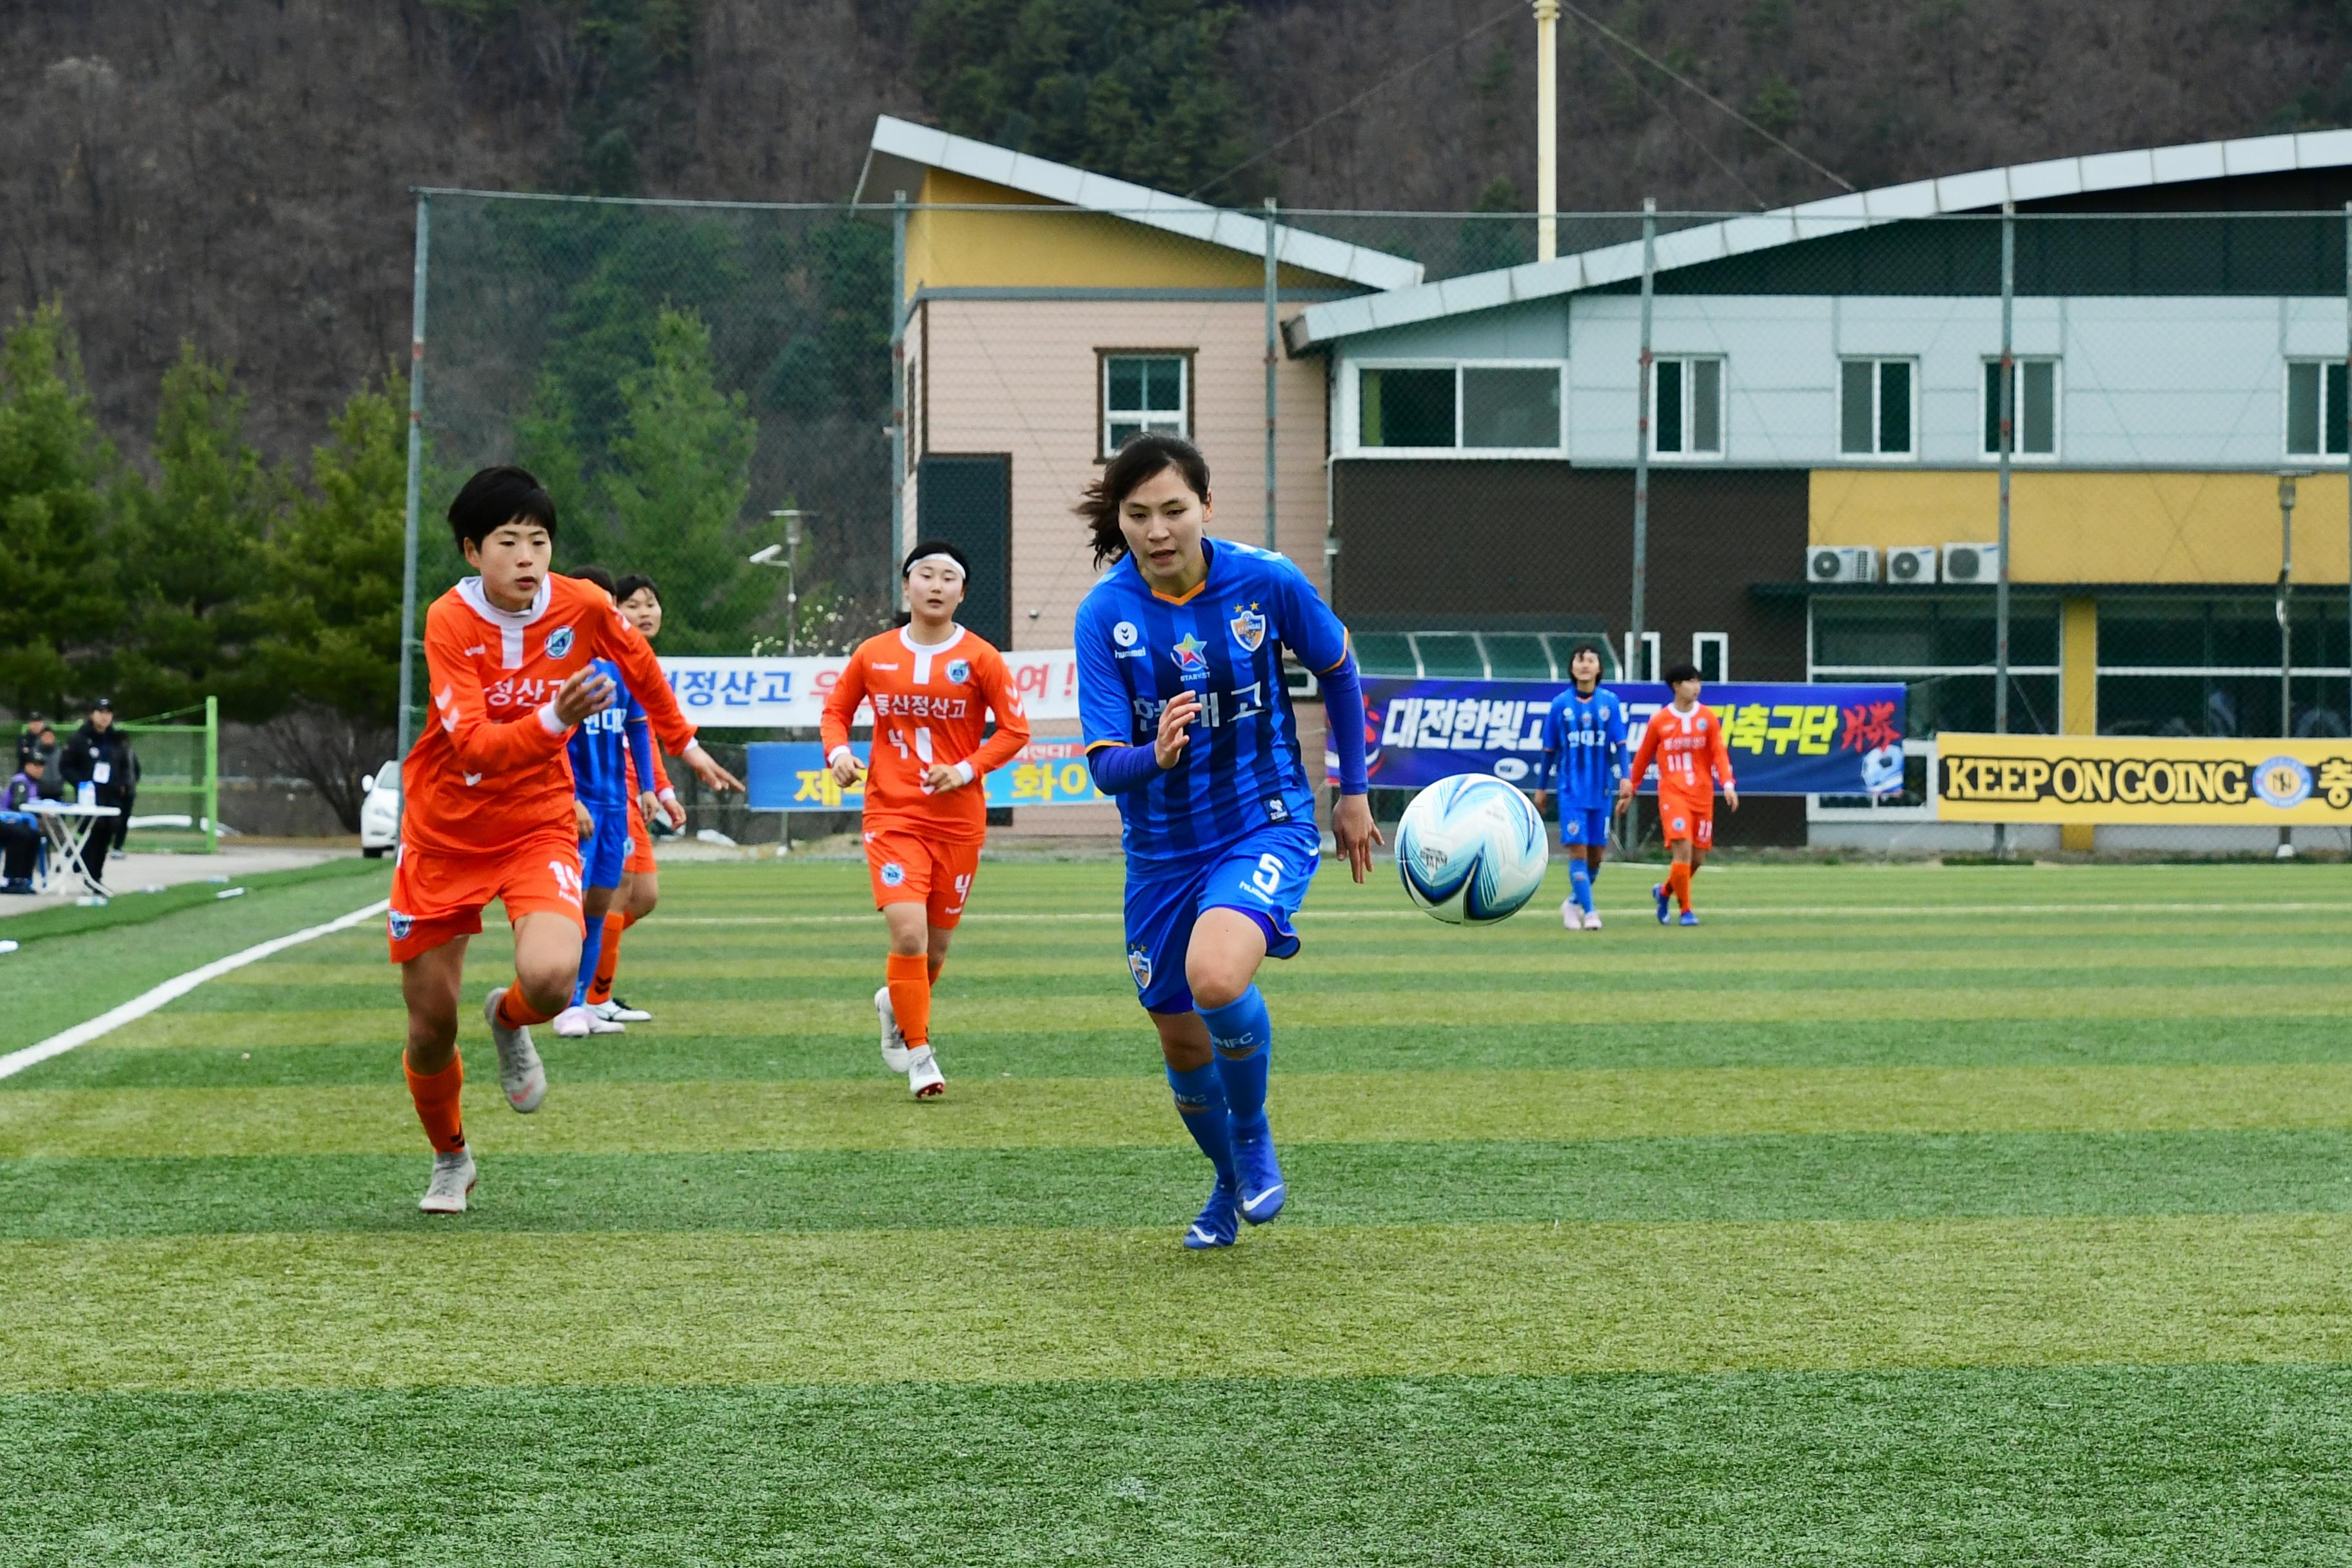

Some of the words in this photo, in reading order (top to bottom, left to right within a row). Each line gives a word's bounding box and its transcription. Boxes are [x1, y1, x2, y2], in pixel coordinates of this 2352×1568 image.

[1115, 646, 1146, 659] hummel
[874, 693, 967, 720] 동산정산고
[1946, 758, 2051, 800] KEEP
[2053, 759, 2113, 801] ON
[2115, 760, 2248, 803] GOING
[1252, 853, 1284, 896] 5
